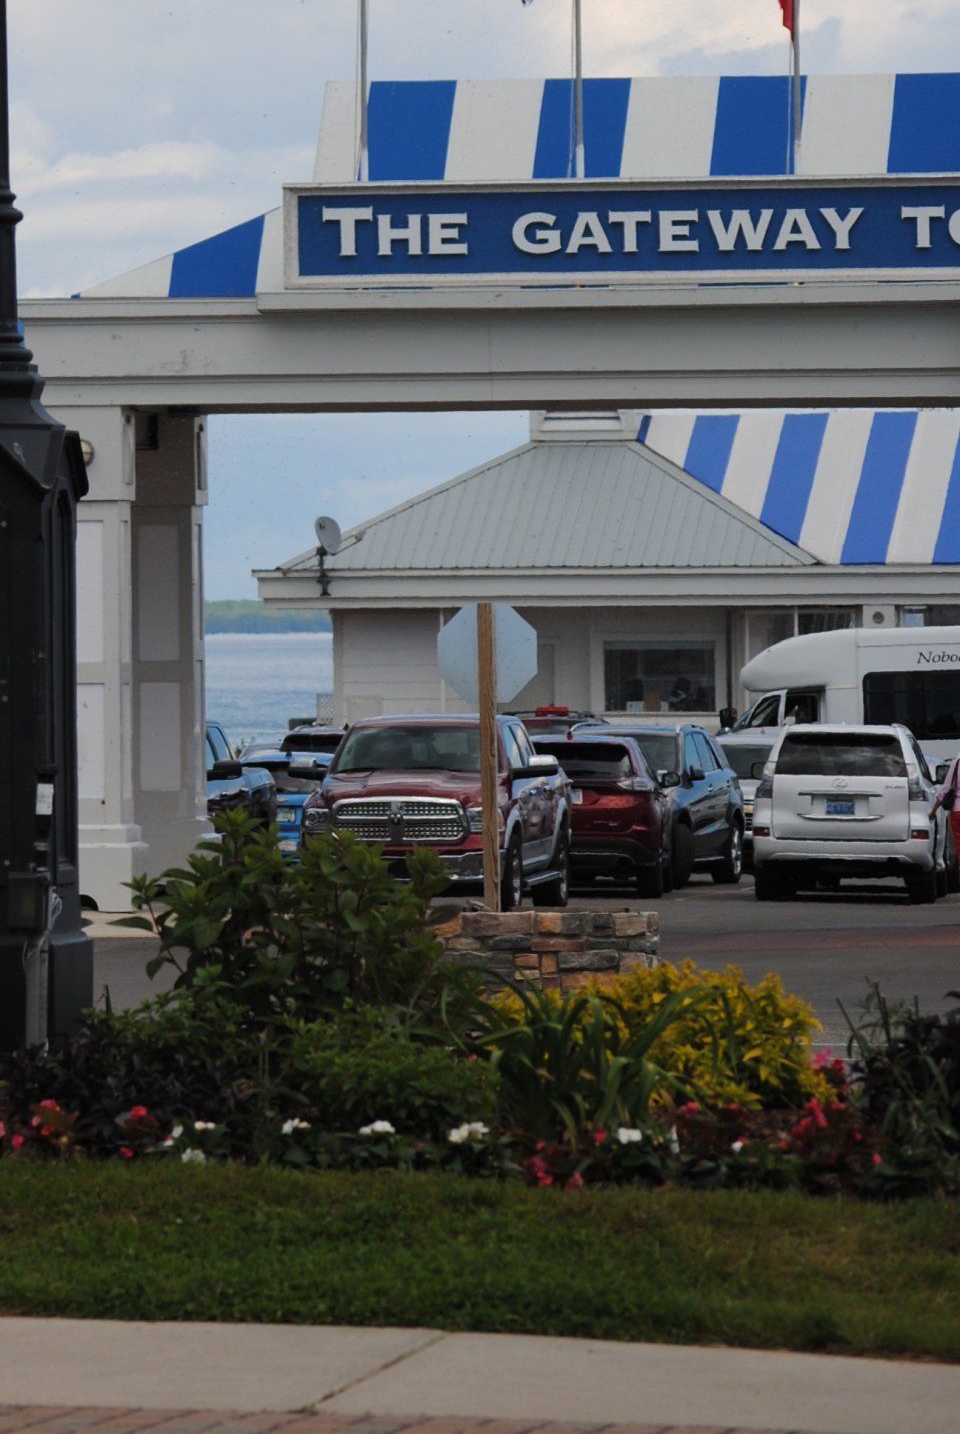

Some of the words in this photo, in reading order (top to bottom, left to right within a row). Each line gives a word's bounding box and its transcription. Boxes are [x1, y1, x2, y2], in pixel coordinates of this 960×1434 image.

[322, 205, 468, 257] THE
[511, 207, 865, 255] GATEWAY
[902, 204, 960, 248] T
